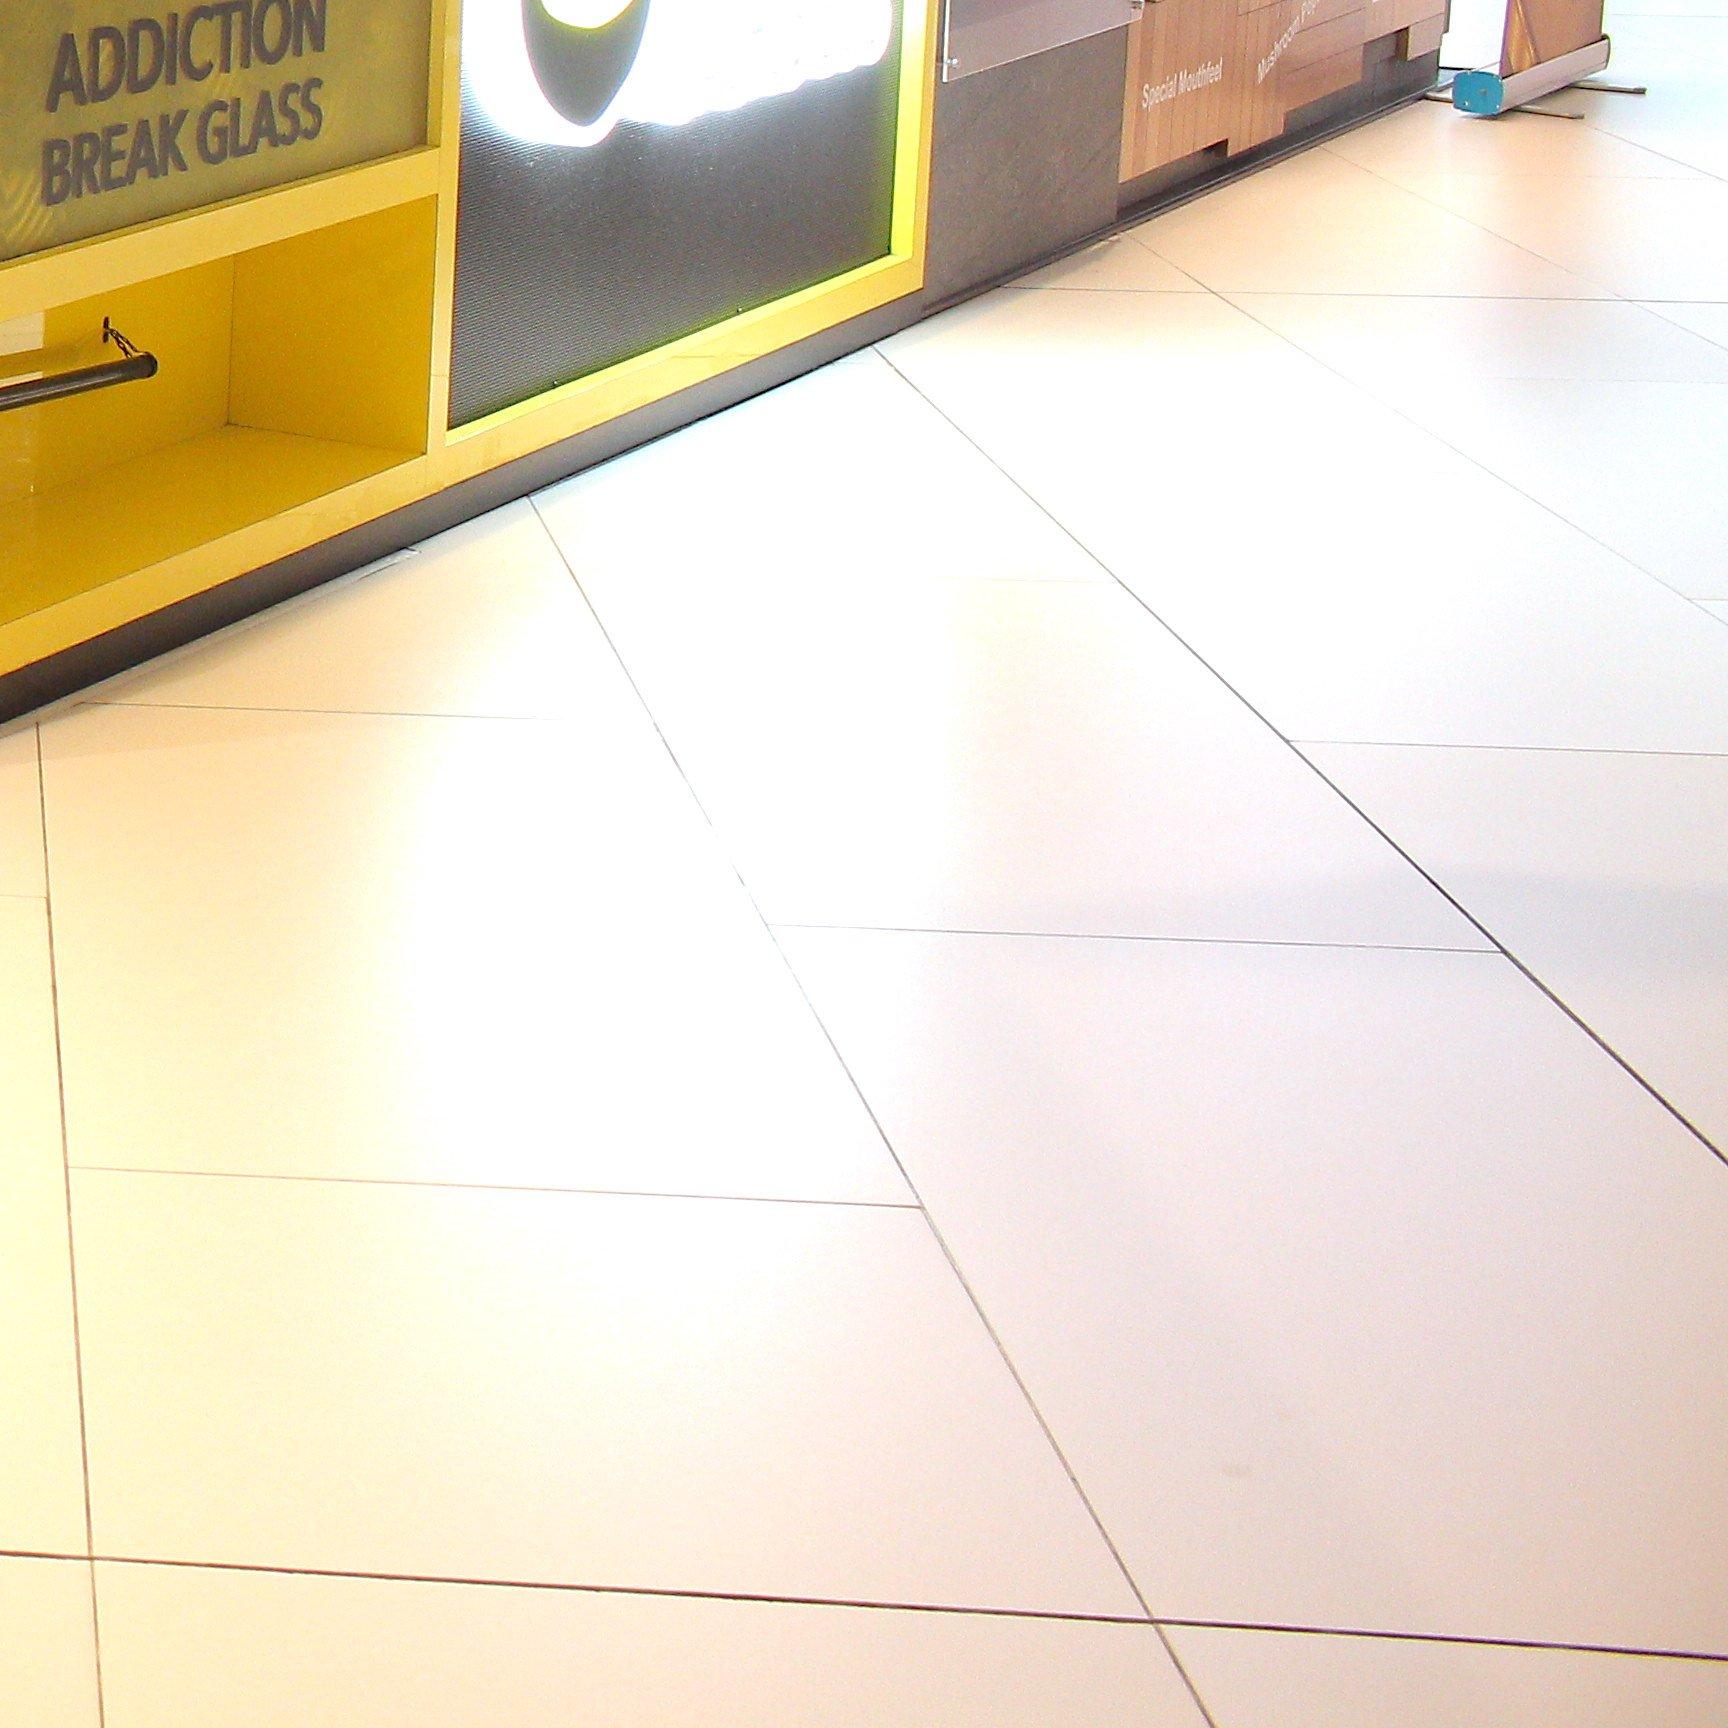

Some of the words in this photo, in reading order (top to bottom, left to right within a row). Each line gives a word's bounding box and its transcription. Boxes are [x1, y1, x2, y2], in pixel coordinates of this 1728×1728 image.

[1141, 75, 1178, 111] Special
[1176, 55, 1224, 97] Mouthfeel
[1257, 16, 1301, 85] Mushroom
[42, 108, 190, 207] BREAK
[196, 77, 324, 166] GLASS
